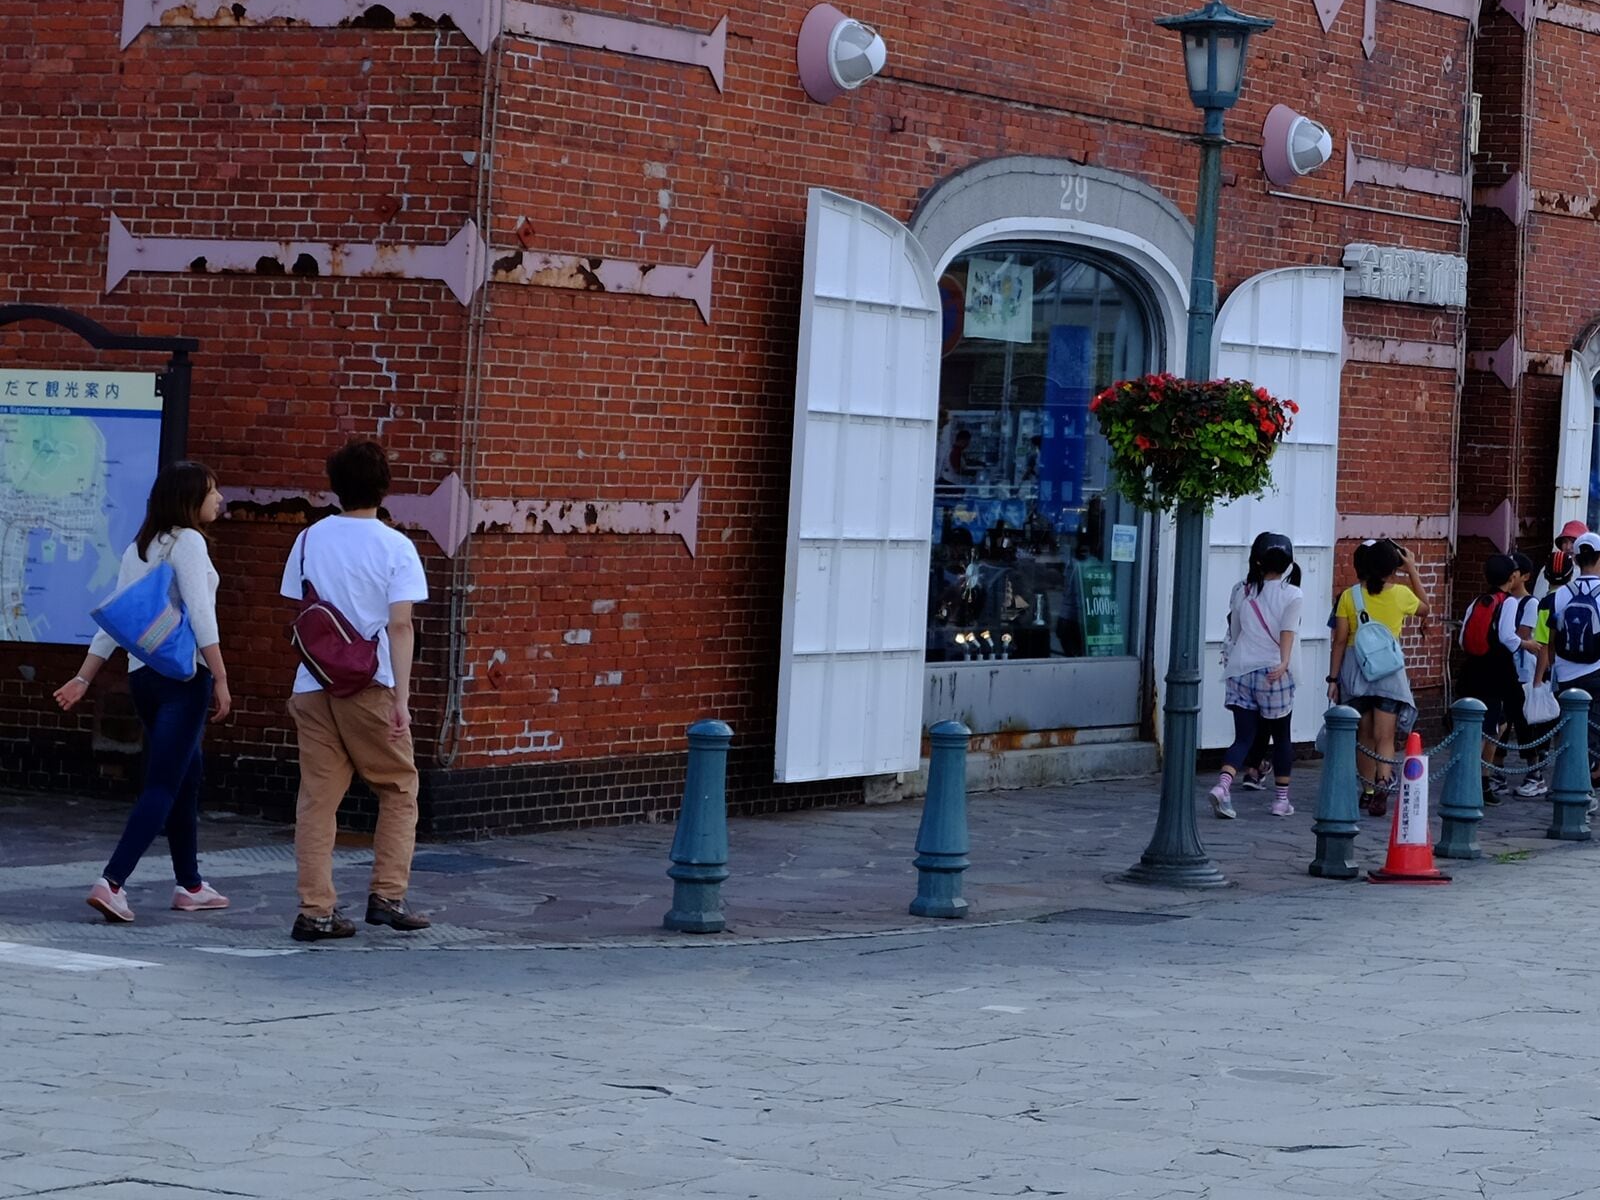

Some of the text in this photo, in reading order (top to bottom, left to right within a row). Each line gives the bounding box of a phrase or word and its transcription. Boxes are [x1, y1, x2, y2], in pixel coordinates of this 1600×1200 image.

[1060, 175, 1088, 212] 29
[4, 380, 120, 400] だて観光案内
